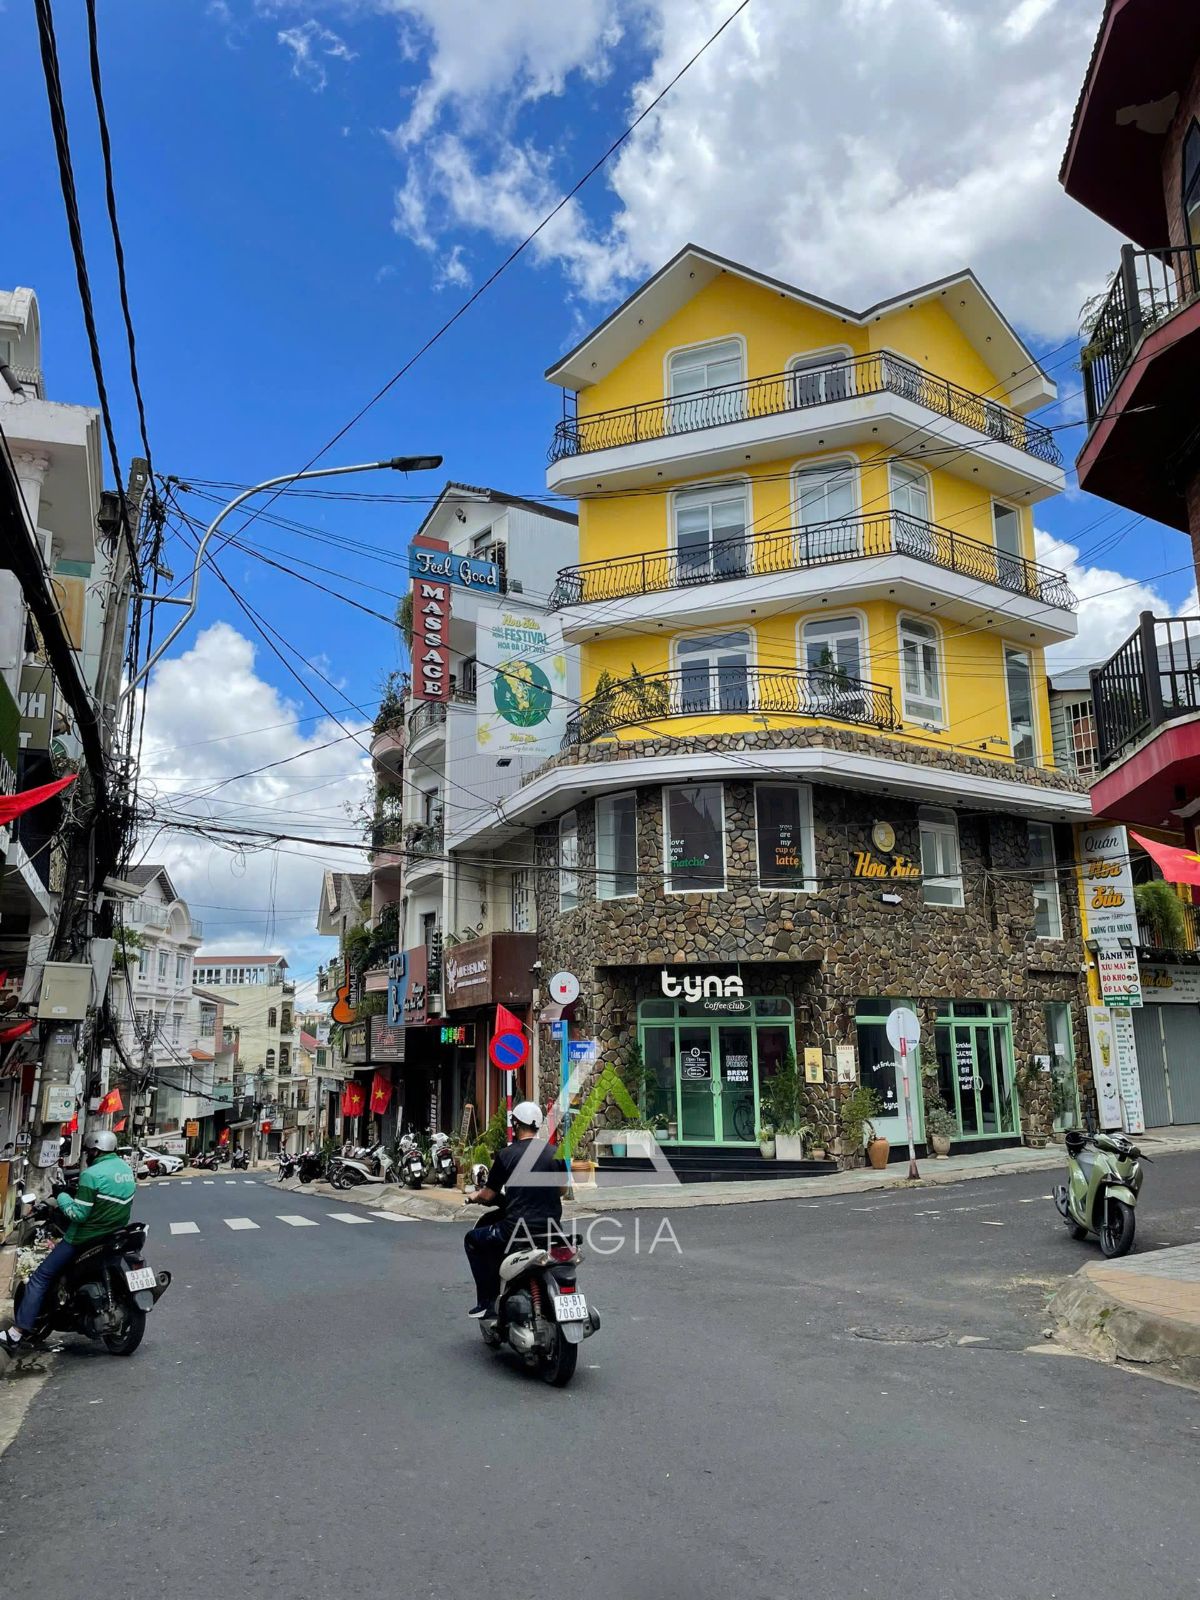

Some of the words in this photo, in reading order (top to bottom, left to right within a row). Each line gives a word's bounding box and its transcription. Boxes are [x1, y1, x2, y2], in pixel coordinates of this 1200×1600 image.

[416, 553, 453, 577] Feel
[459, 560, 497, 585] Good
[421, 584, 445, 696] MASSAGE
[505, 628, 549, 645] FESTIVAL
[789, 846, 797, 855] of
[1085, 836, 1118, 852] Quán
[671, 857, 705, 867] matcha
[776, 855, 800, 865] latte
[854, 851, 888, 877] Hoa
[1087, 856, 1122, 880] Hoa
[1100, 951, 1123, 960] BÁNH
[661, 971, 744, 1003] tyna
[704, 1002, 727, 1011] Coffee
[728, 1001, 744, 1010] club
[558, 1306, 587, 1319] 70603
